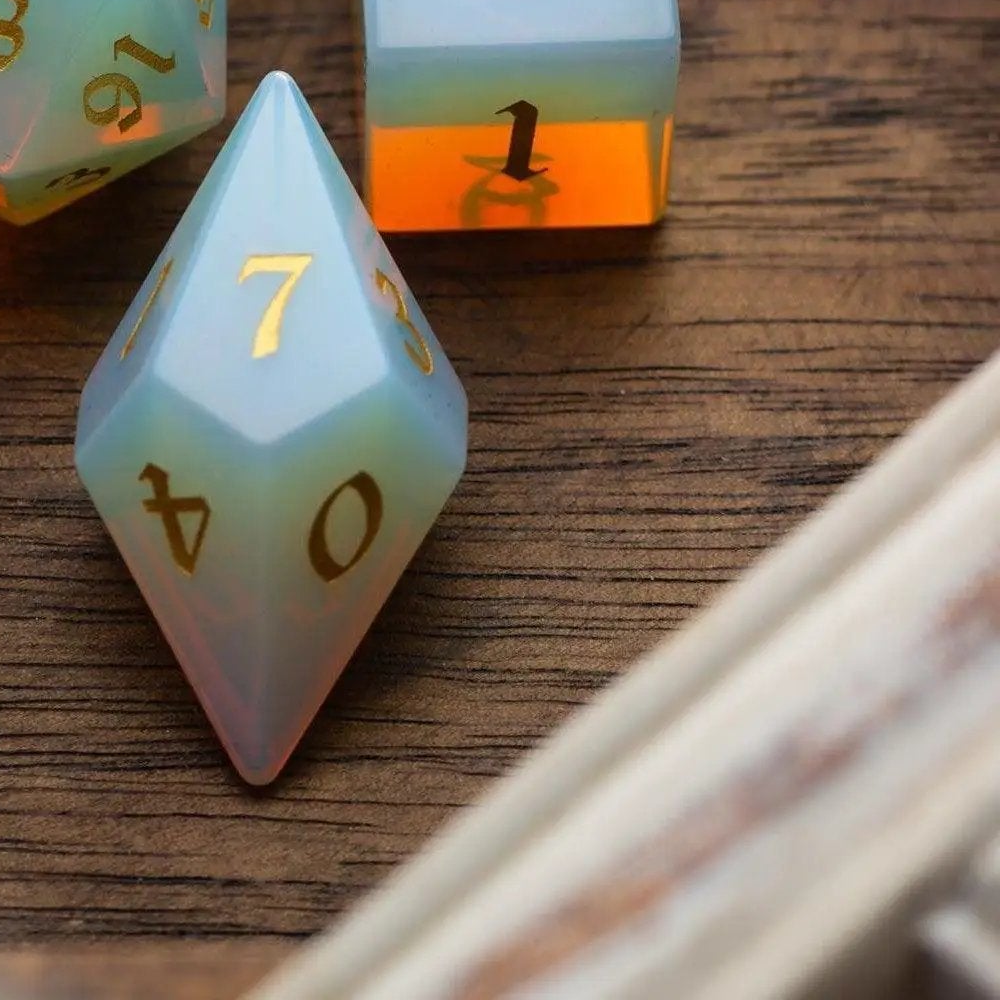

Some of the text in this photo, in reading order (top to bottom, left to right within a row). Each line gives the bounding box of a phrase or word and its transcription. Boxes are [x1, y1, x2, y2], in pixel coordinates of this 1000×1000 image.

[494, 99, 549, 182] 1
[237, 253, 315, 359] 7
[138, 462, 211, 579] 4
[308, 469, 383, 583] 0
